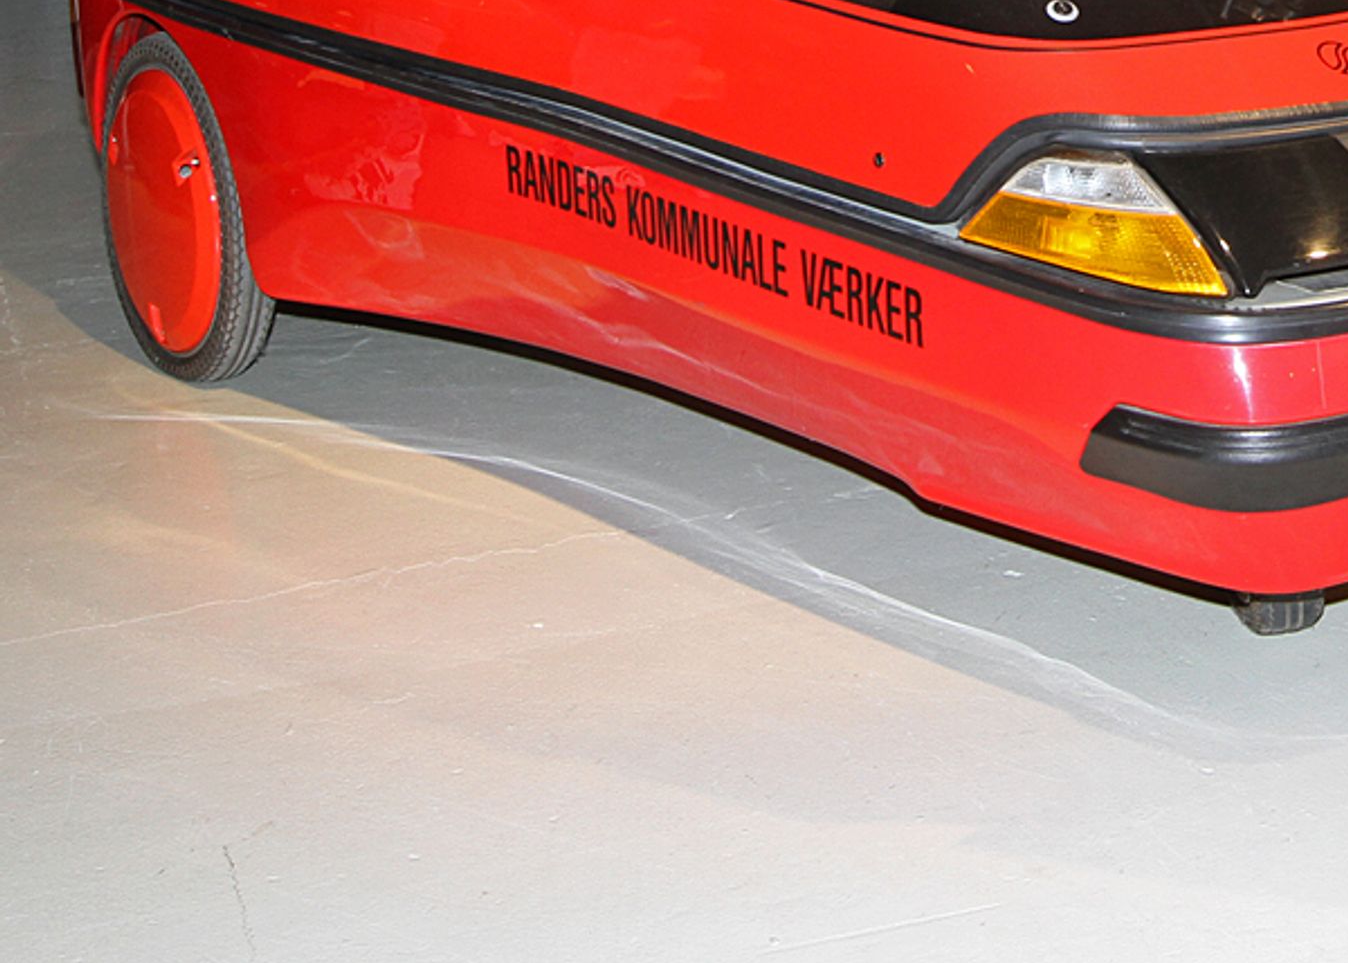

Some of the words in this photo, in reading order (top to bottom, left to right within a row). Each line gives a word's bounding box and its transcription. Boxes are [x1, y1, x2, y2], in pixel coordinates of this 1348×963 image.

[505, 144, 617, 230] RANDERS
[626, 184, 789, 298] KOMMUNALE
[799, 247, 925, 349] VÆRKER
